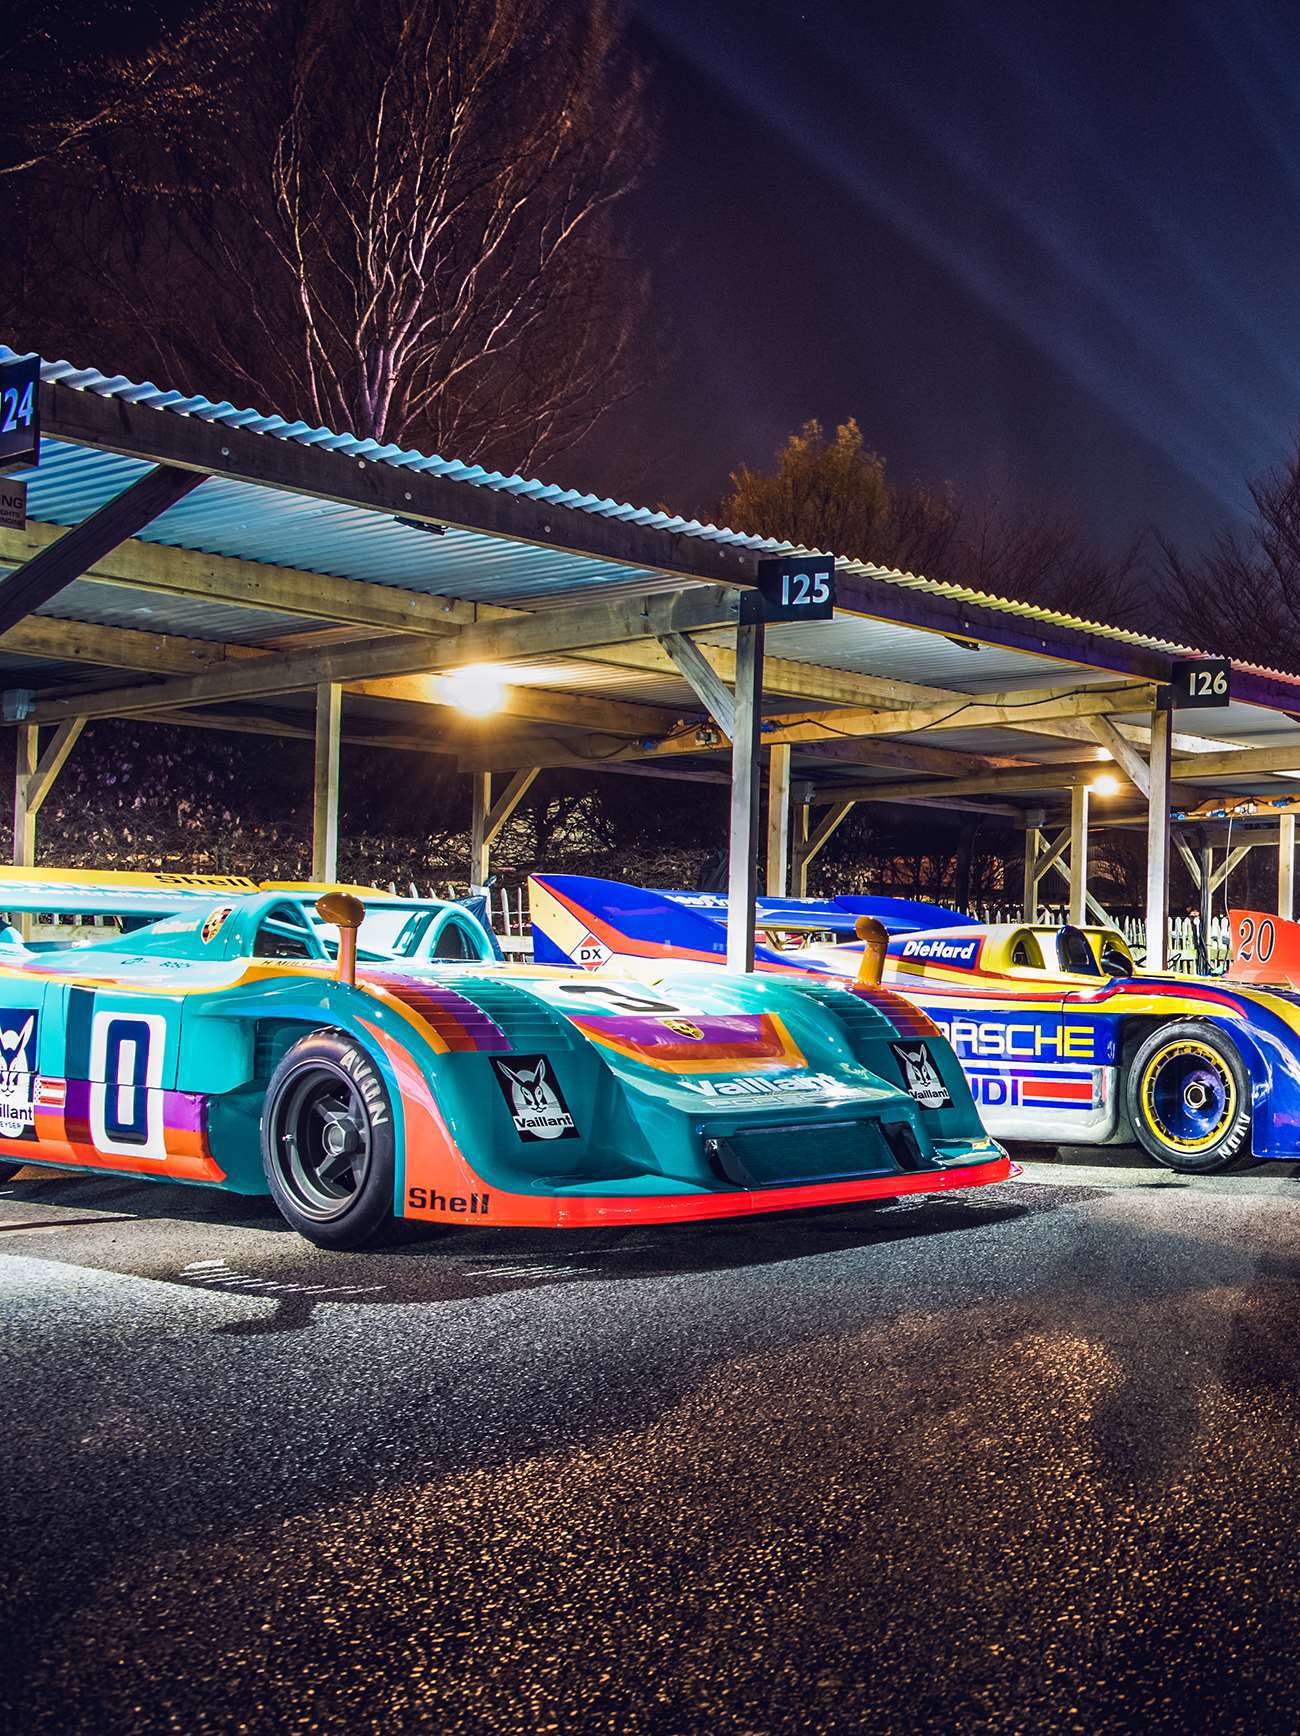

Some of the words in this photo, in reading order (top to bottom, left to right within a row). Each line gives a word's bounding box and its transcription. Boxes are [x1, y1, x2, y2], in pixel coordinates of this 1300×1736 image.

[0, 382, 34, 433] 24
[0, 495, 23, 509] NG
[782, 572, 830, 605] 125
[1189, 671, 1228, 696] 126
[154, 875, 249, 887] Shell
[902, 940, 976, 960] DieHard
[1236, 917, 1276, 964] 20
[580, 948, 602, 960] DX
[340, 1048, 389, 1127] AVON
[678, 1072, 846, 1097] Vaillant
[910, 1088, 949, 1101] Vaillant
[514, 1114, 573, 1129] Vaillant
[1217, 1111, 1251, 1159] AVON
[408, 1187, 490, 1215] Shell
